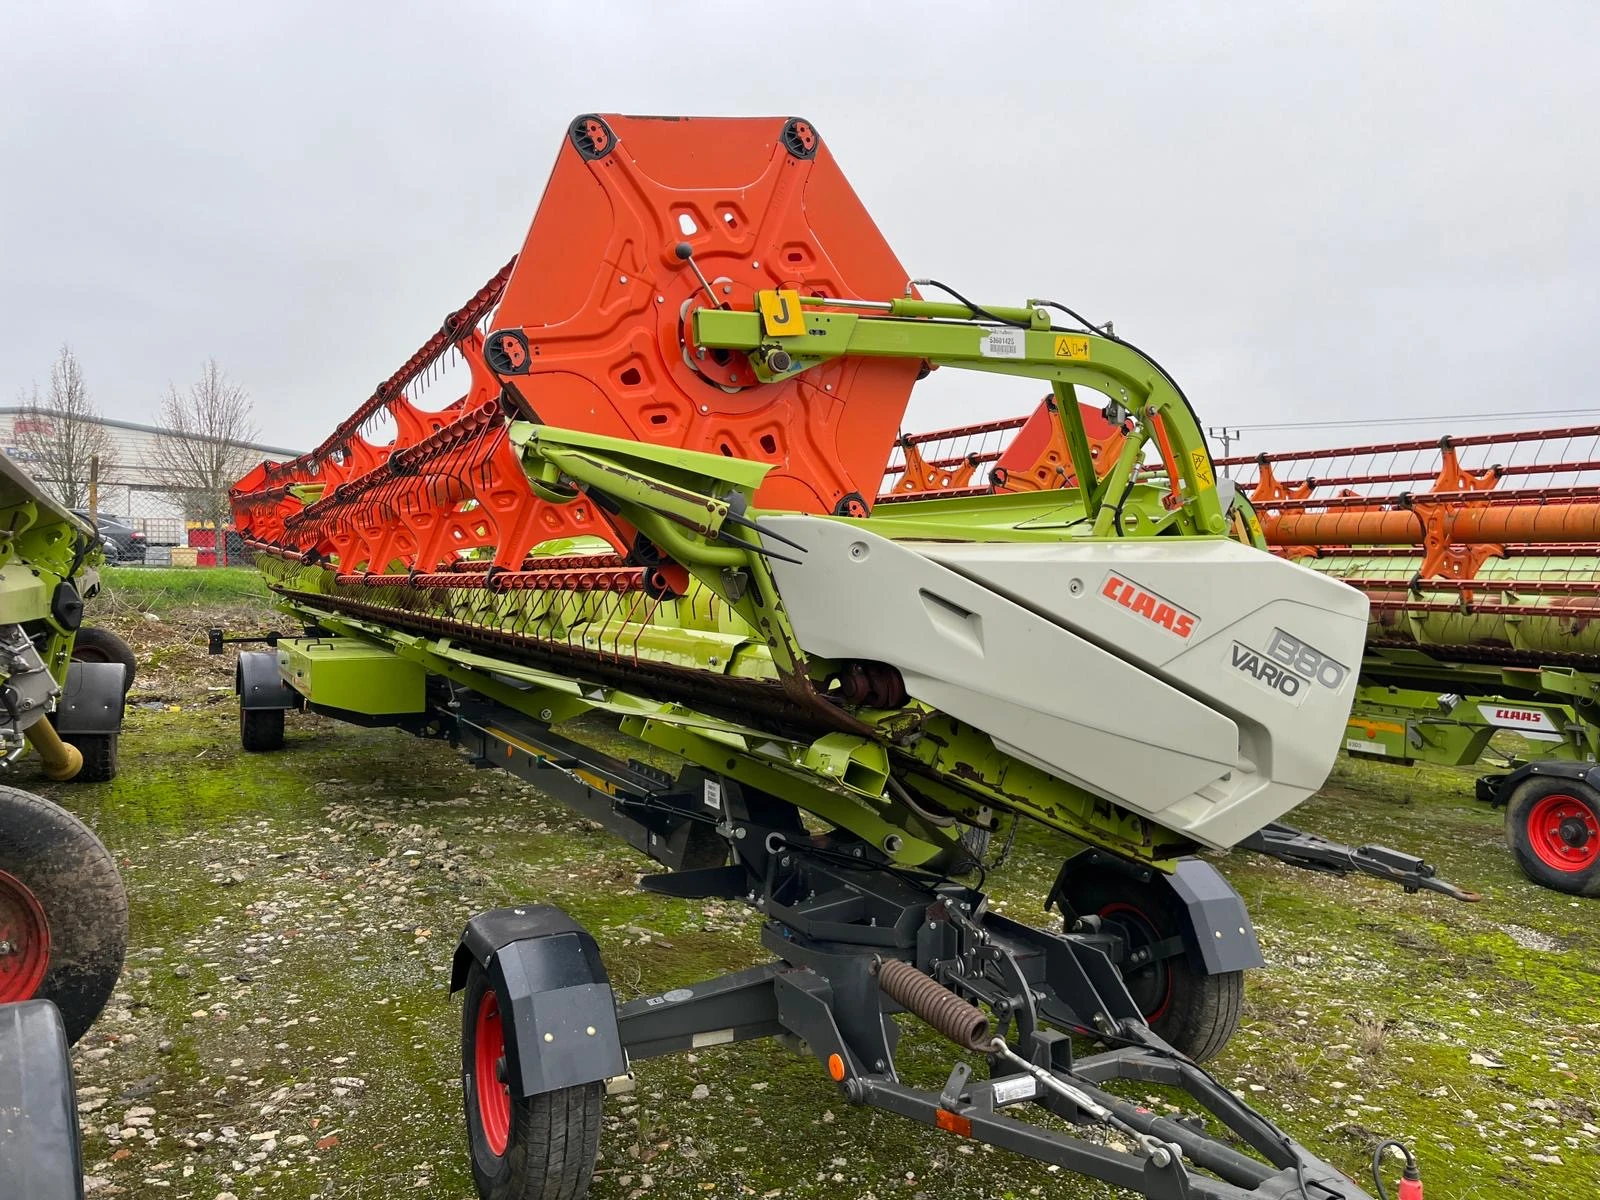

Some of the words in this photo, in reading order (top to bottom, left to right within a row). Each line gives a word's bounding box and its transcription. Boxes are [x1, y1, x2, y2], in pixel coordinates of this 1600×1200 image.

[773, 298, 790, 324] J
[1102, 576, 1195, 639] CLAAS
[1230, 645, 1300, 697] VARIO
[1495, 709, 1542, 724] CLAAS
